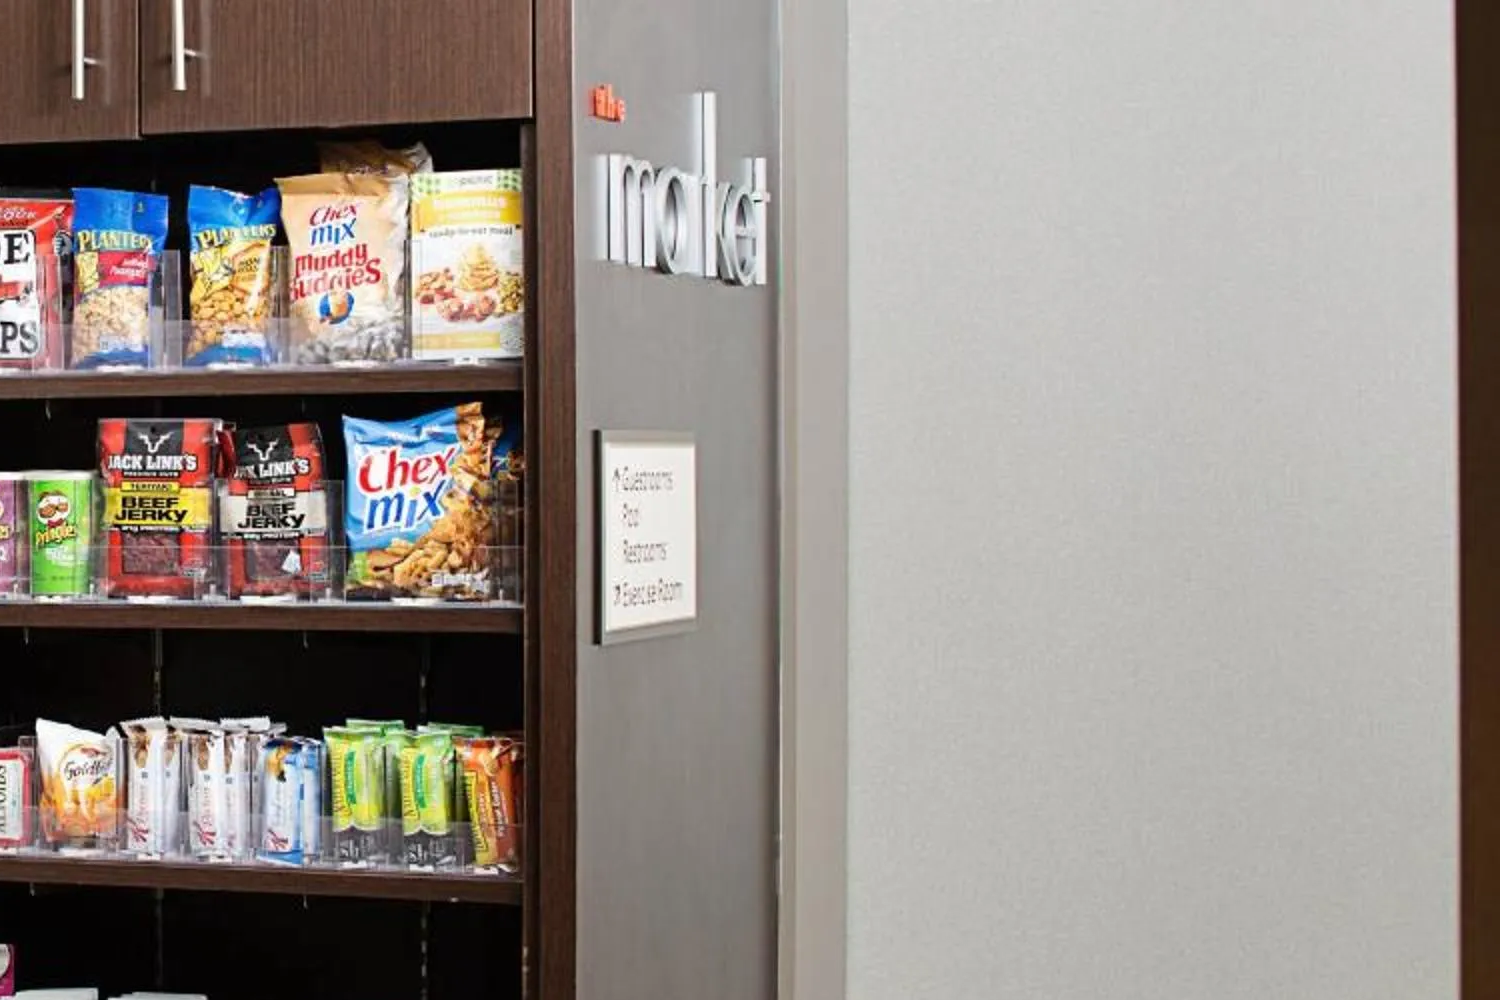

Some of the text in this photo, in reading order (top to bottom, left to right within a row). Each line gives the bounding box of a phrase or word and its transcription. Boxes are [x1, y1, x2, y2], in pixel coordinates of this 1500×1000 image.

[108, 454, 198, 471] JACK LINK'S
[258, 459, 310, 477] LINK'S
[358, 447, 457, 493] Chex
[121, 496, 180, 509] BEEF
[115, 509, 188, 523] JERKY
